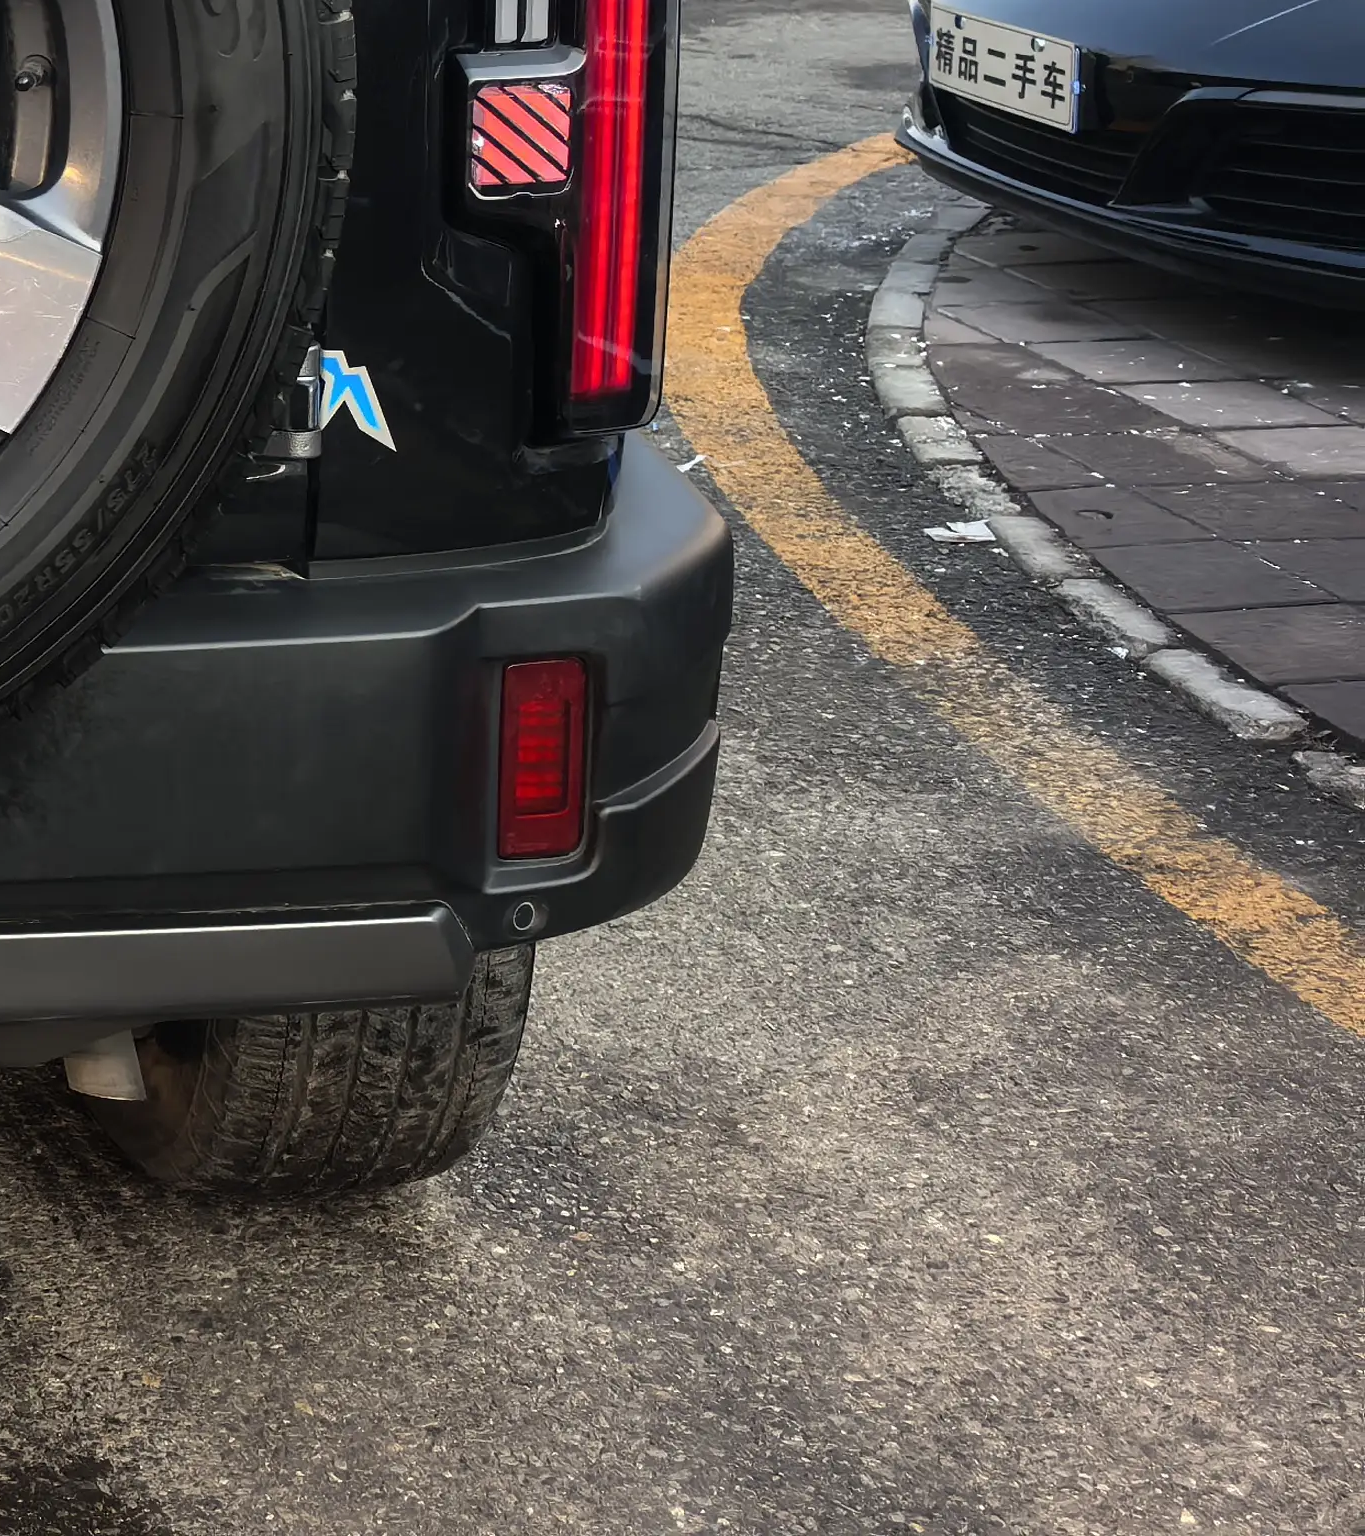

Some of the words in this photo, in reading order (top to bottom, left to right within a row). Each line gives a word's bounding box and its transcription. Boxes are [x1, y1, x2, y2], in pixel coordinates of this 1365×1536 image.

[935, 27, 1067, 110] 精品二手车
